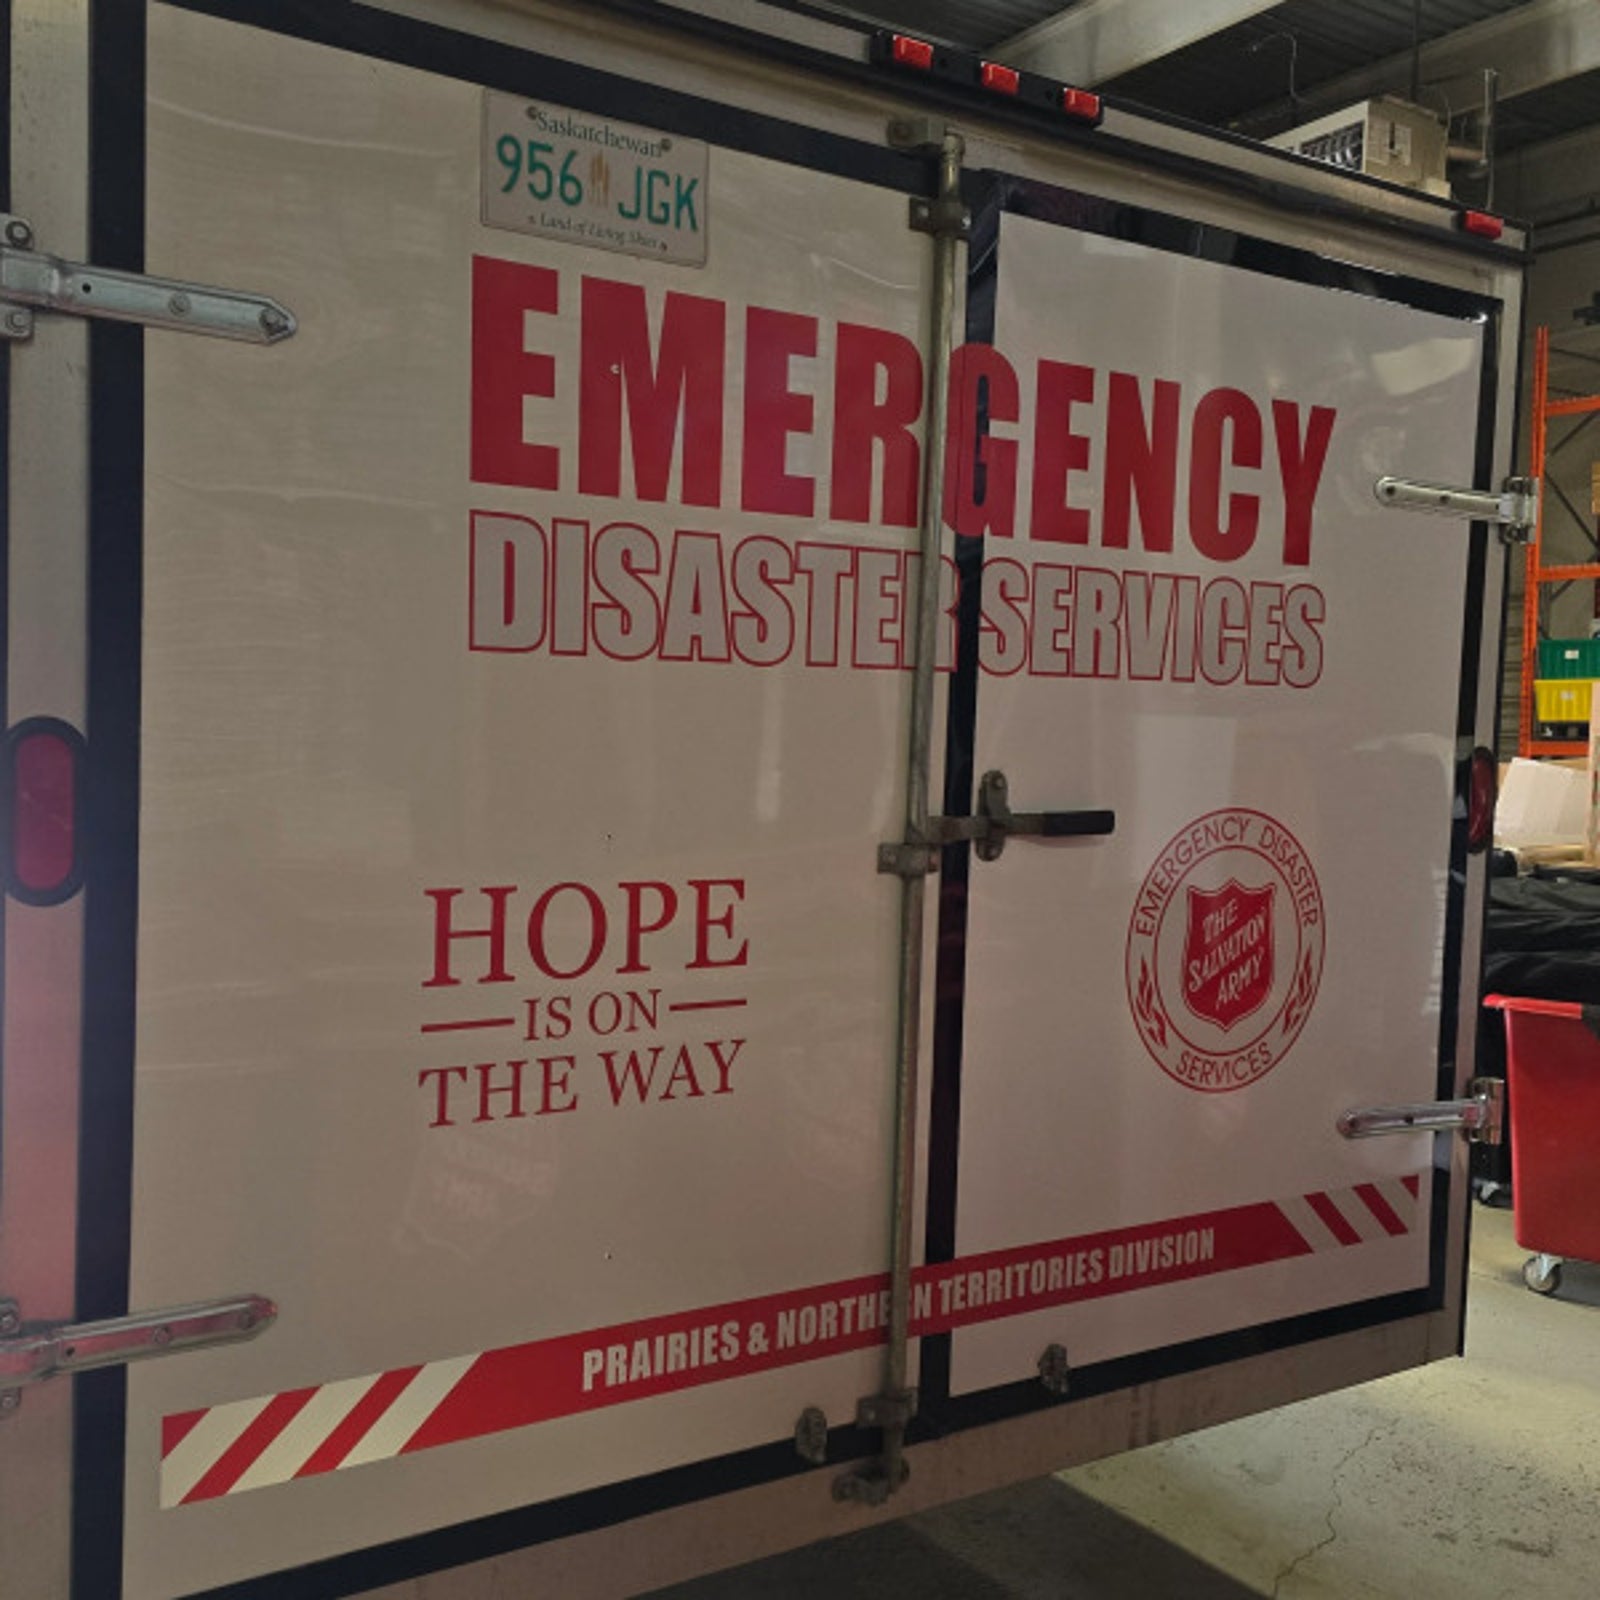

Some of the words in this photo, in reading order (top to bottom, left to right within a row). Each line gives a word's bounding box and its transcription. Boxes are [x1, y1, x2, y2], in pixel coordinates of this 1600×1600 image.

[537, 111, 663, 158] Saskatchewan
[496, 134, 583, 207] 956
[618, 165, 698, 233] JGK
[469, 254, 1337, 567] EMERGENCY
[469, 509, 961, 673] DISASTER
[977, 556, 1326, 689] SERVICES
[1135, 816, 1251, 937] EMERGENCY
[1258, 825, 1319, 927] DISASTER
[1203, 898, 1239, 944] THE
[421, 879, 749, 988] HOPE
[1189, 905, 1267, 993] SALVATION
[1215, 946, 1265, 1011] ARMY
[523, 996, 573, 1041] IS
[588, 989, 662, 1036] ON
[418, 1055, 579, 1129] THE
[597, 1039, 747, 1107] WAY
[1175, 1041, 1273, 1087] SERVICES
[581, 1320, 741, 1393] PRAIRIES
[747, 1322, 769, 1356] &
[776, 1281, 933, 1351] NORTHEN
[938, 1247, 1104, 1316] TERRITORIES
[1108, 1227, 1216, 1279] DIVISION
